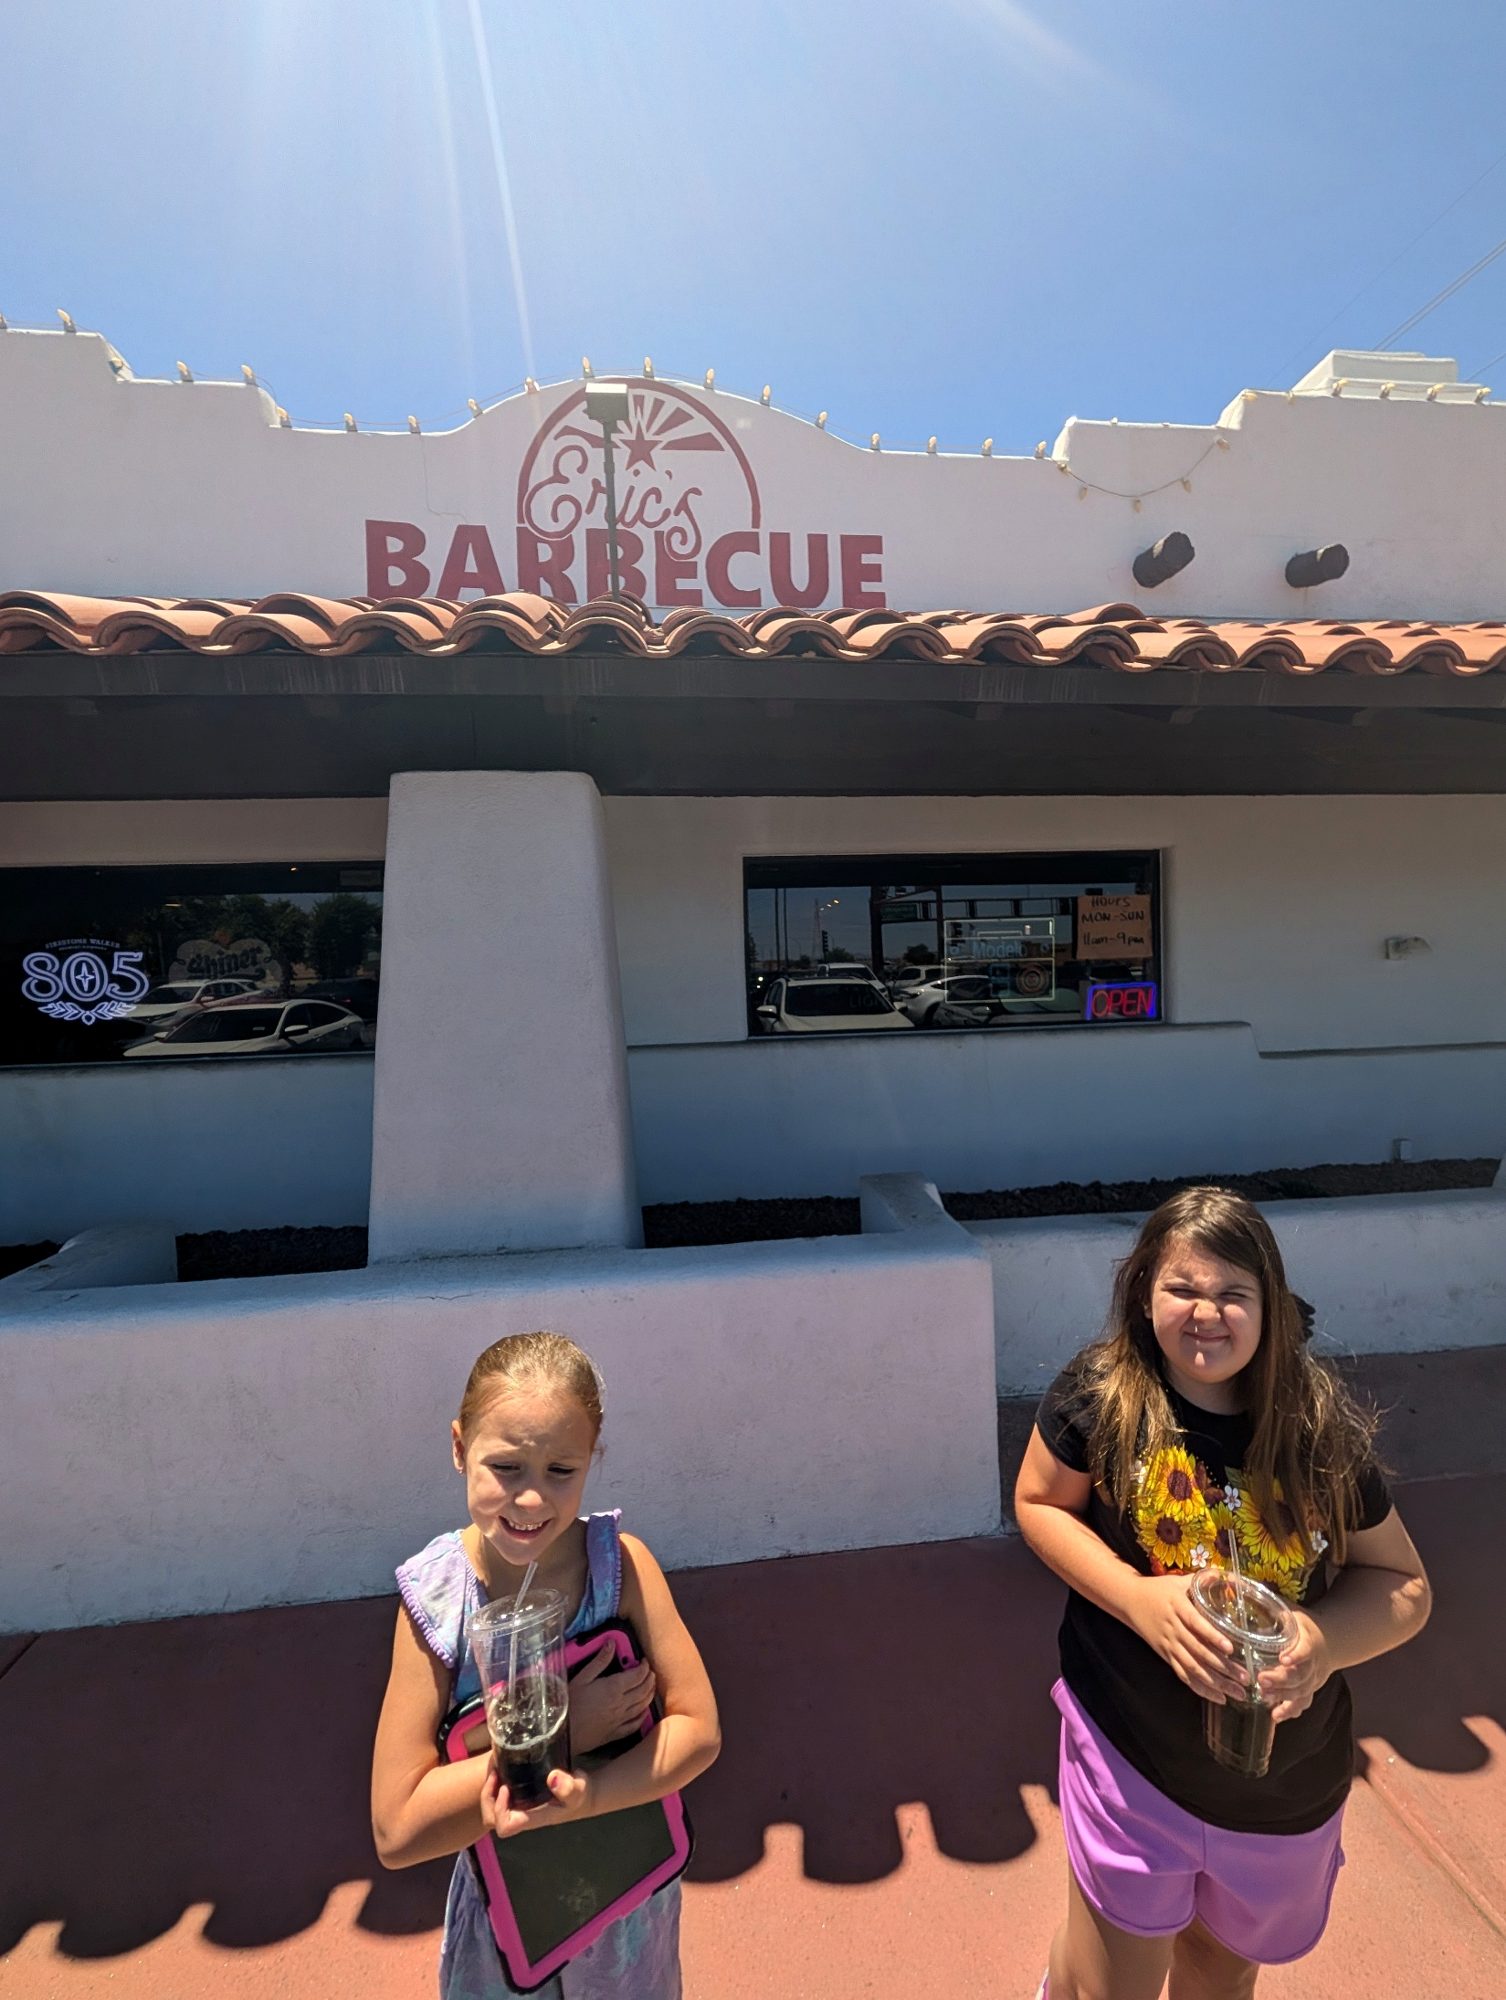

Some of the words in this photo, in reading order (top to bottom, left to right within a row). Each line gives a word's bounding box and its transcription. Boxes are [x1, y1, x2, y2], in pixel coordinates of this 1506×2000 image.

[523, 444, 704, 561] Eric's
[365, 519, 887, 609] BARBECUE
[21, 951, 149, 1002] 805
[1091, 987, 1153, 1018] OPEN
